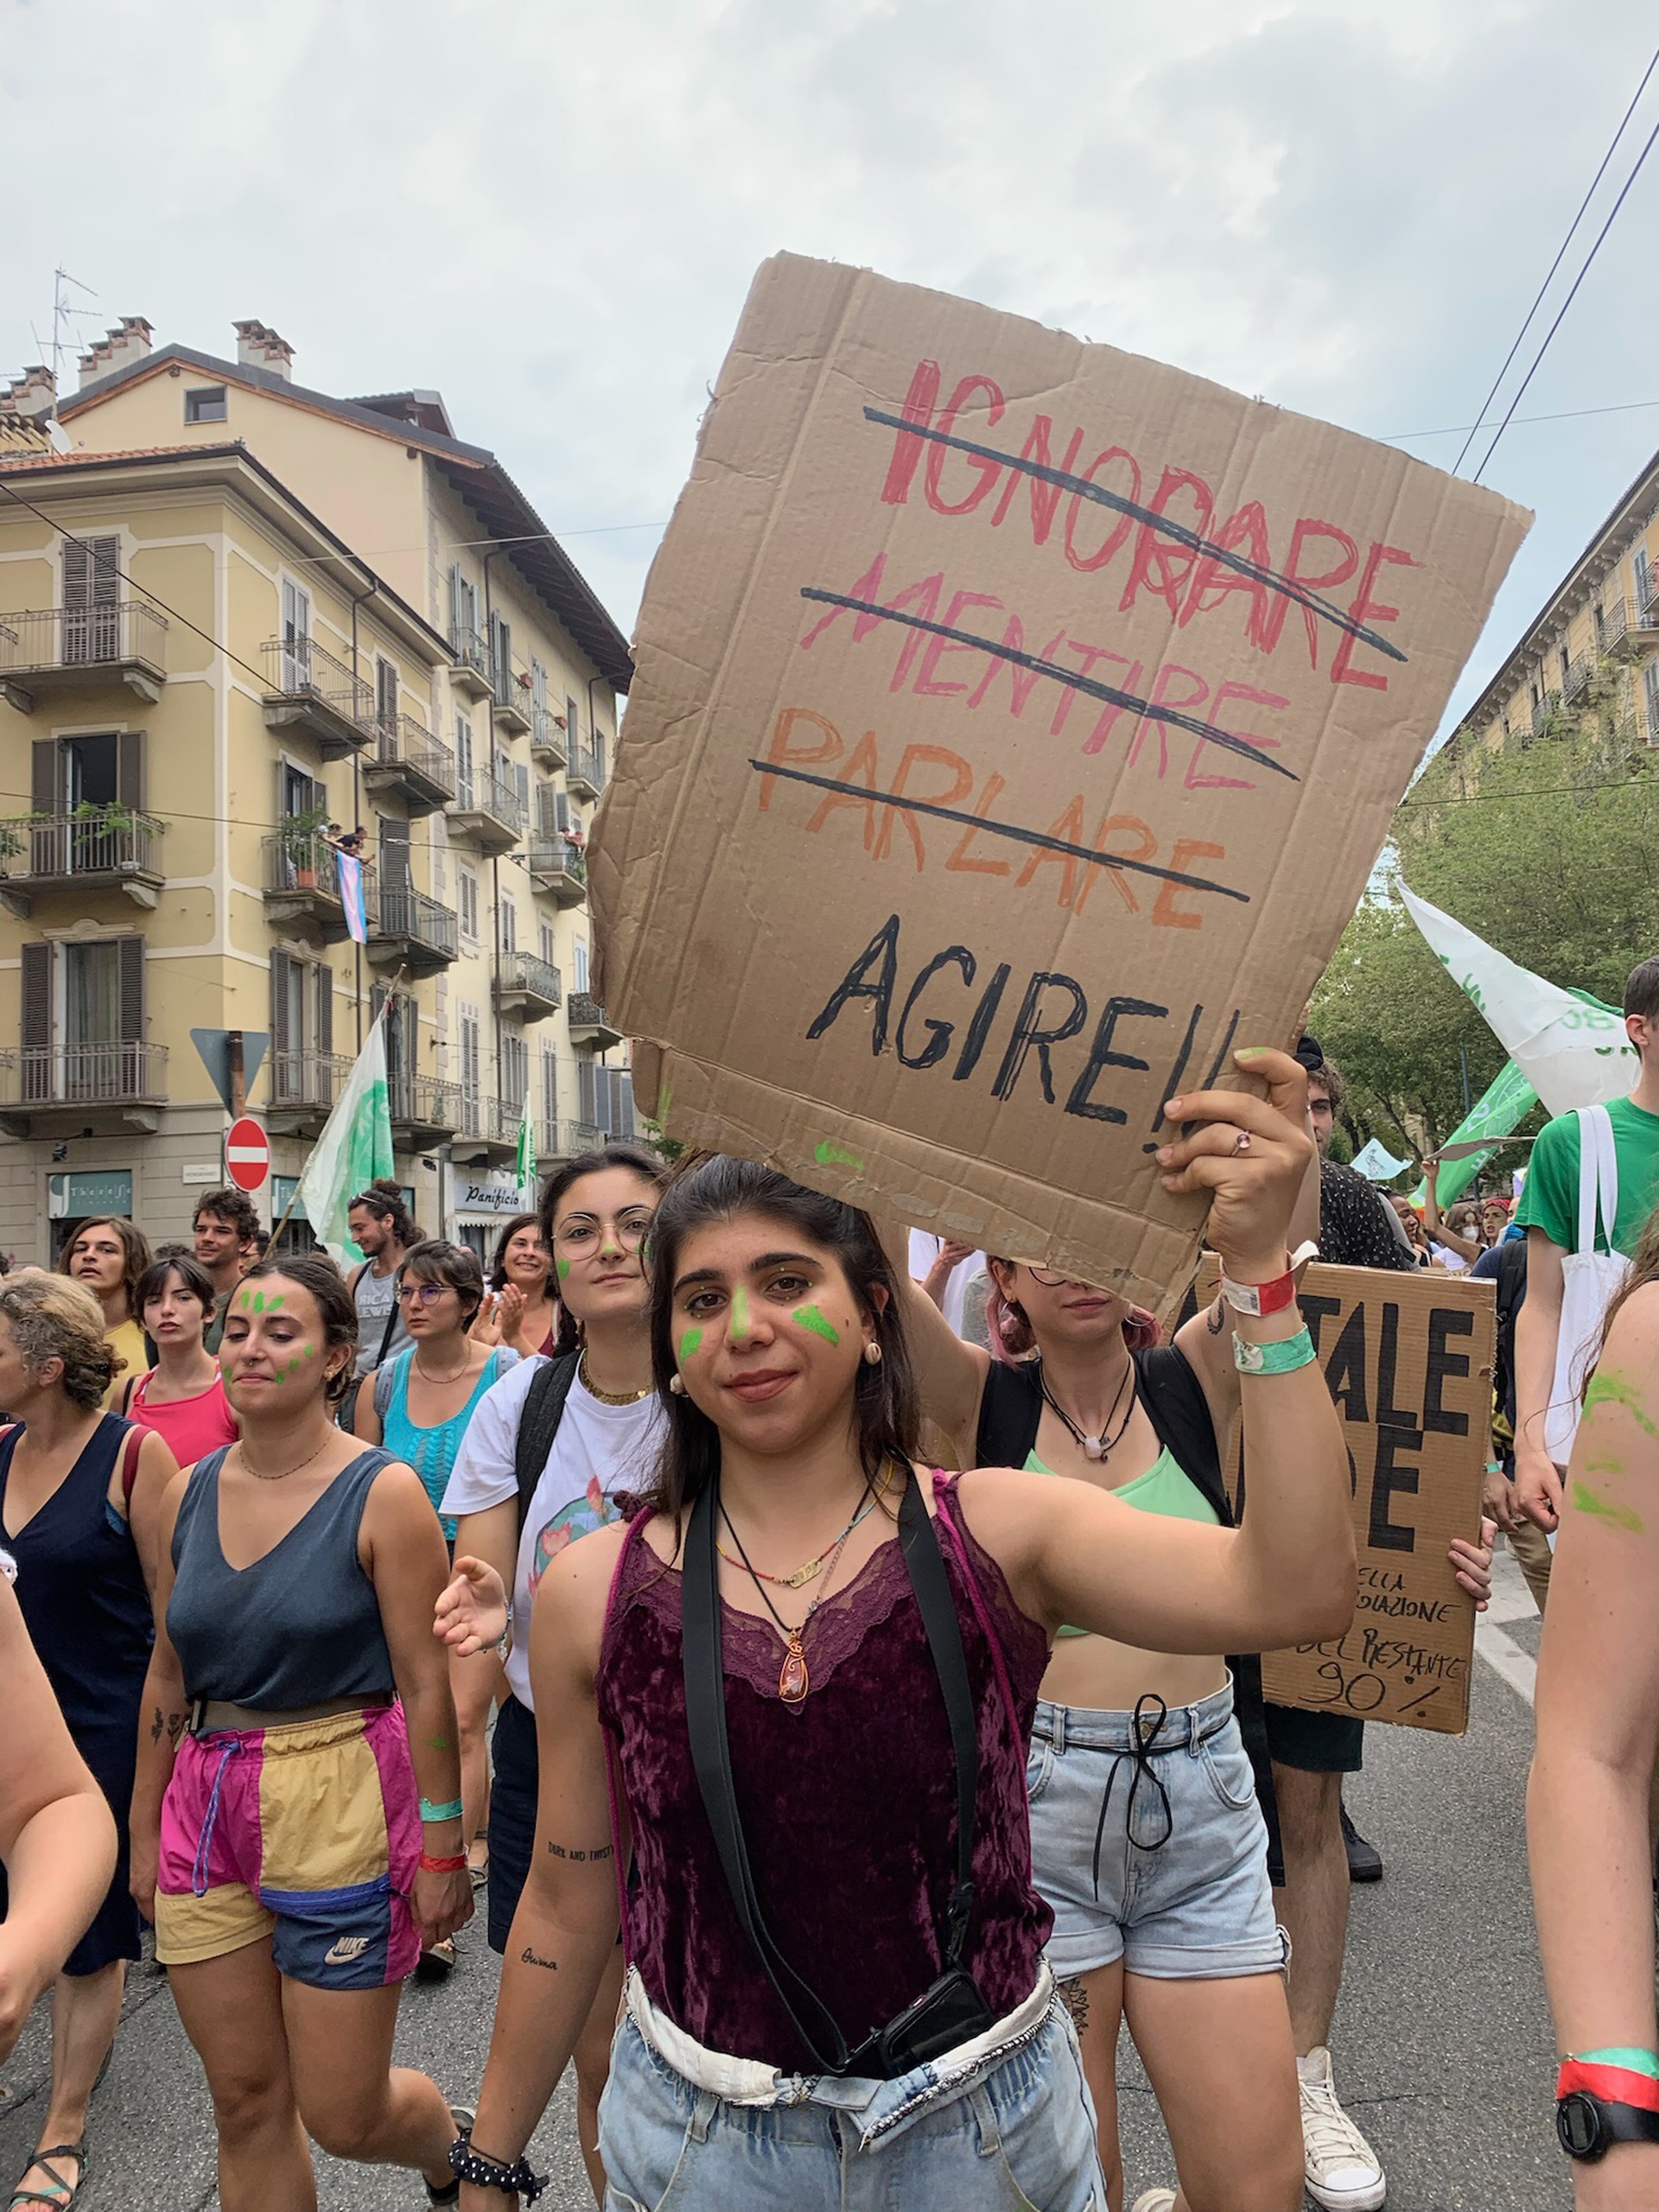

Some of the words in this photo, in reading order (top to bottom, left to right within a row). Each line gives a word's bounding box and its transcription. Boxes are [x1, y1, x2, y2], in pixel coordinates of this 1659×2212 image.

[882, 359, 1426, 690] IGNORARE
[800, 553, 1291, 789] MENTIRE
[759, 707, 1225, 930] PARLARE
[465, 1185, 519, 1210] Panificio
[1298, 1294, 1475, 1437] TALE
[1358, 1567, 1406, 1592] ELLA
[1356, 1594, 1461, 1623] DIAZIONE
[1363, 1628, 1466, 1680] RESTANTE
[569, 1851, 586, 1862] AND
[334, 1936, 370, 1954] NIKE
